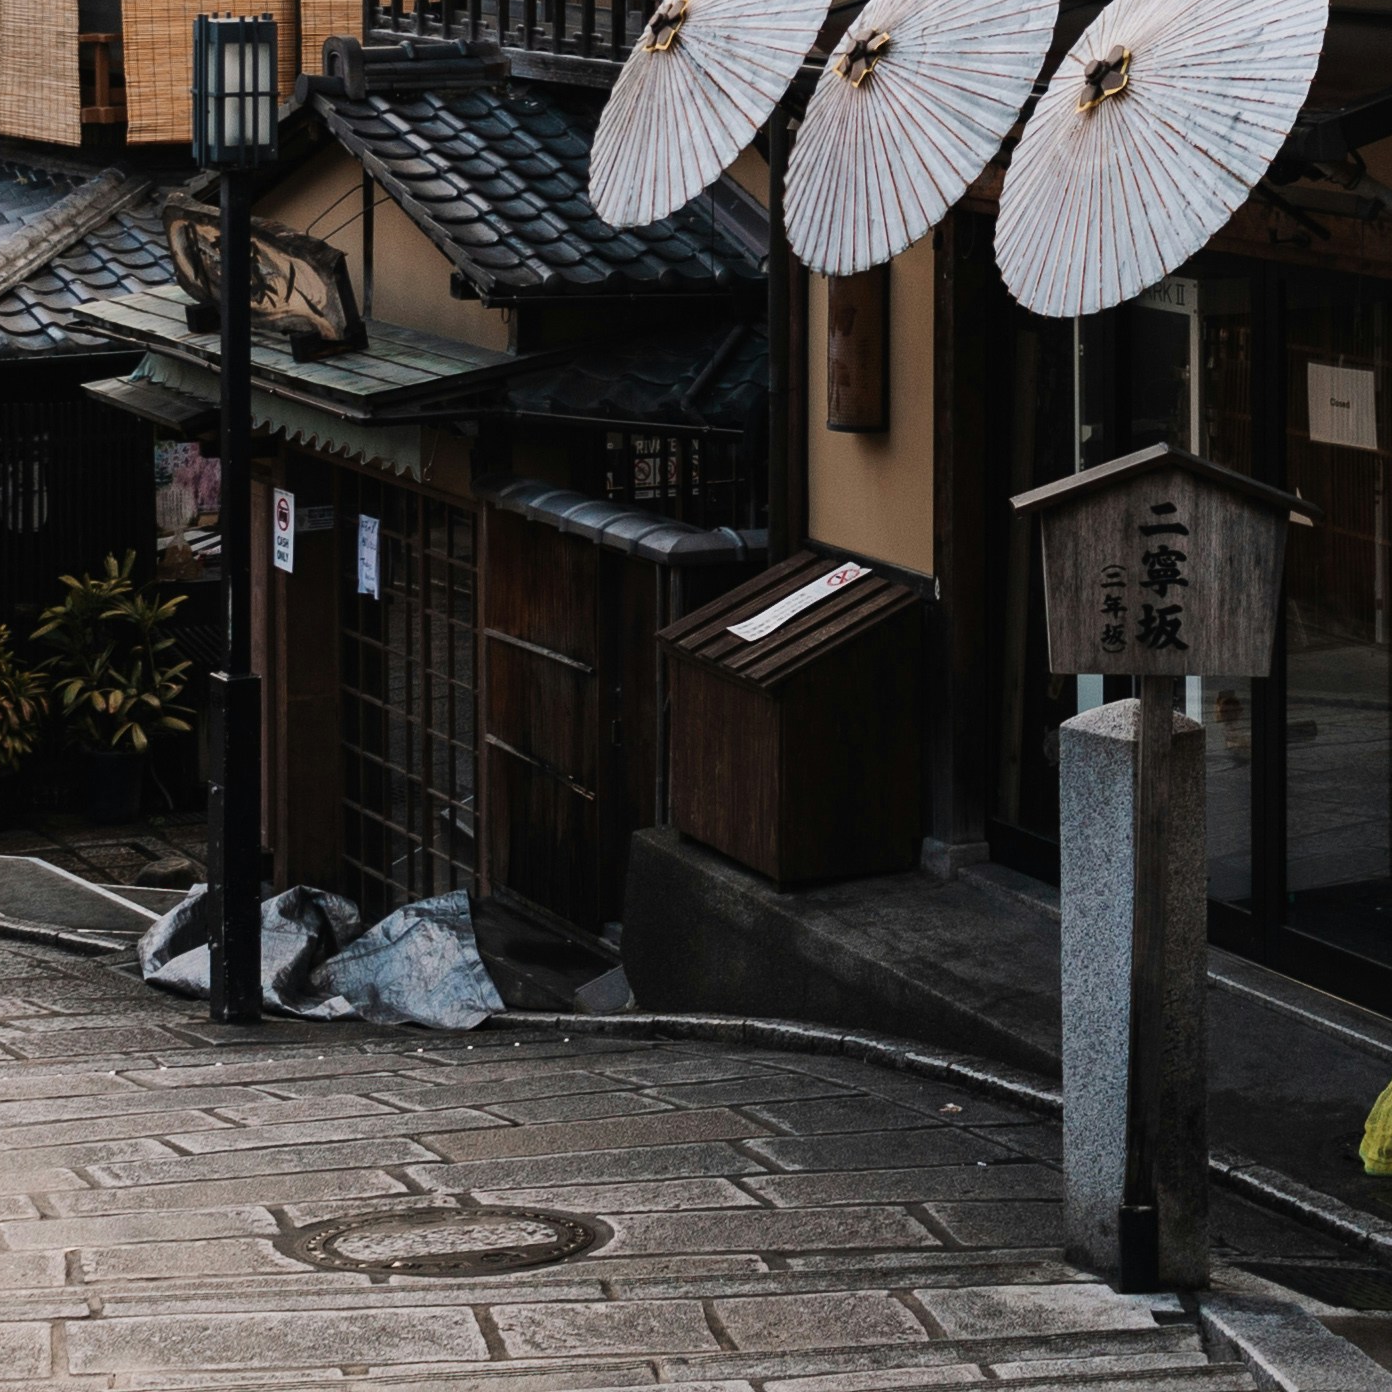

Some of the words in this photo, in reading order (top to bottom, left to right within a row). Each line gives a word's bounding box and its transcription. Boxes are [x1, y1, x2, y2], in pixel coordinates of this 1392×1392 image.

[1330, 397, 1350, 409] Closed
[277, 535, 289, 548] CASH
[277, 550, 289, 562] ONLY
[1135, 501, 1190, 651] 二寧坂
